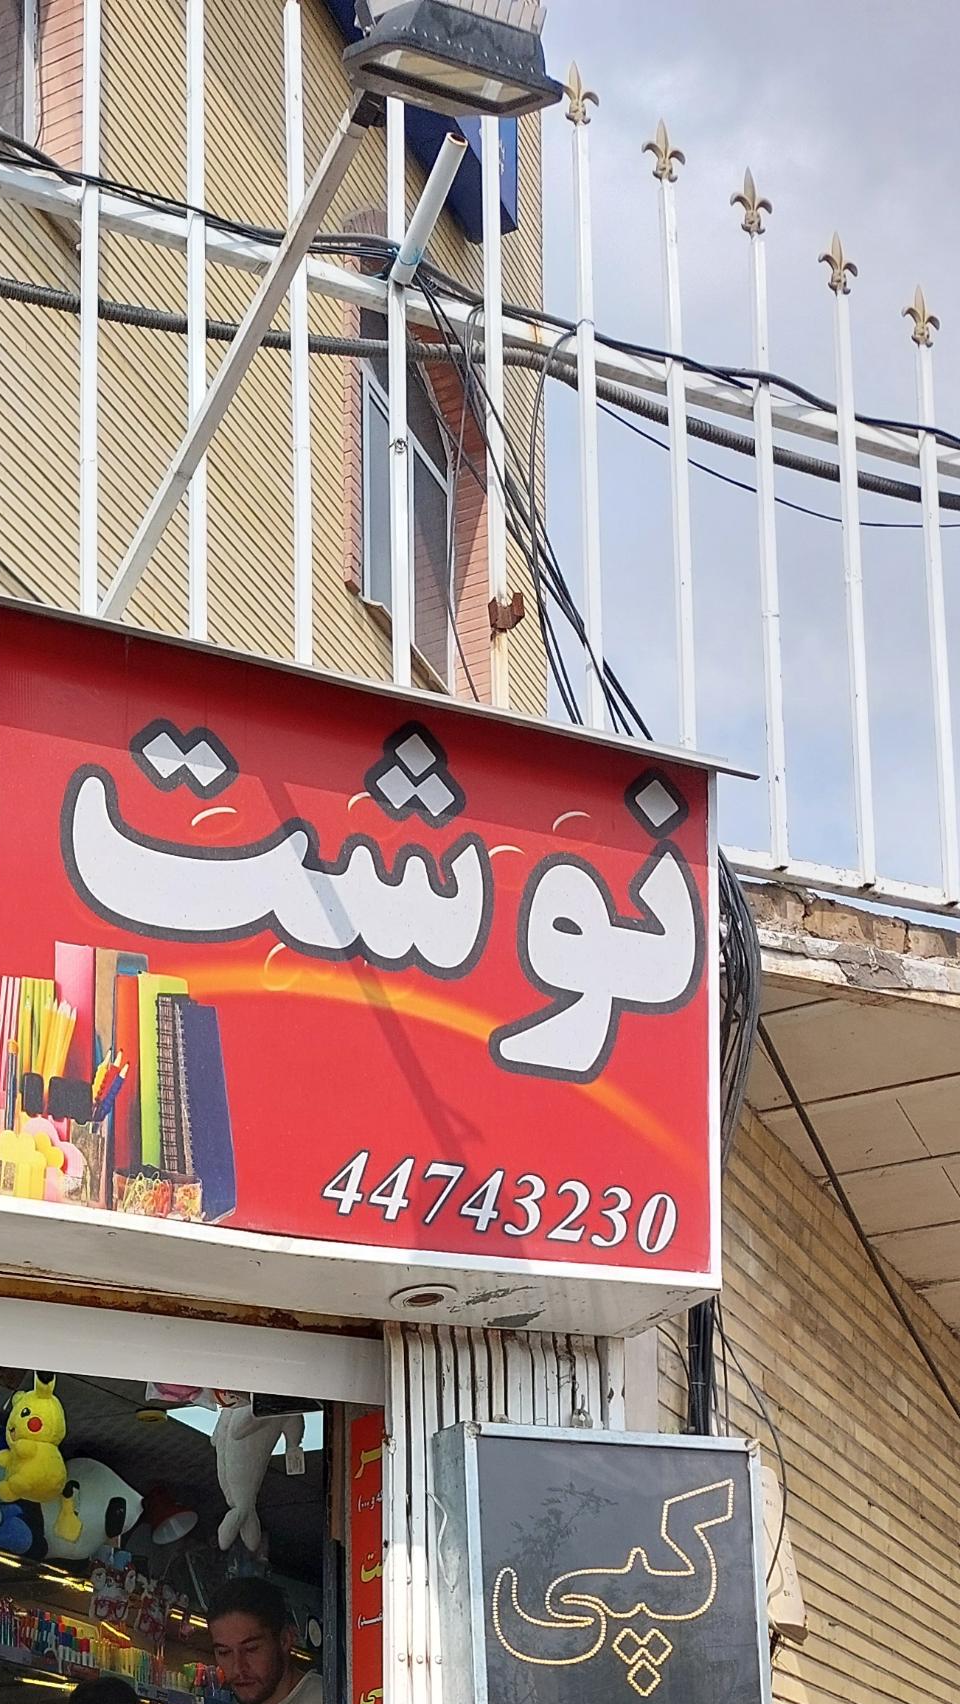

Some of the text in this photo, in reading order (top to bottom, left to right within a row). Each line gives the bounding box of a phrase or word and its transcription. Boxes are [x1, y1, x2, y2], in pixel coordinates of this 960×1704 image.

[60, 719, 706, 1084] نوشت
[321, 1149, 679, 1257] 44743230
[493, 1478, 734, 1697] کپی
